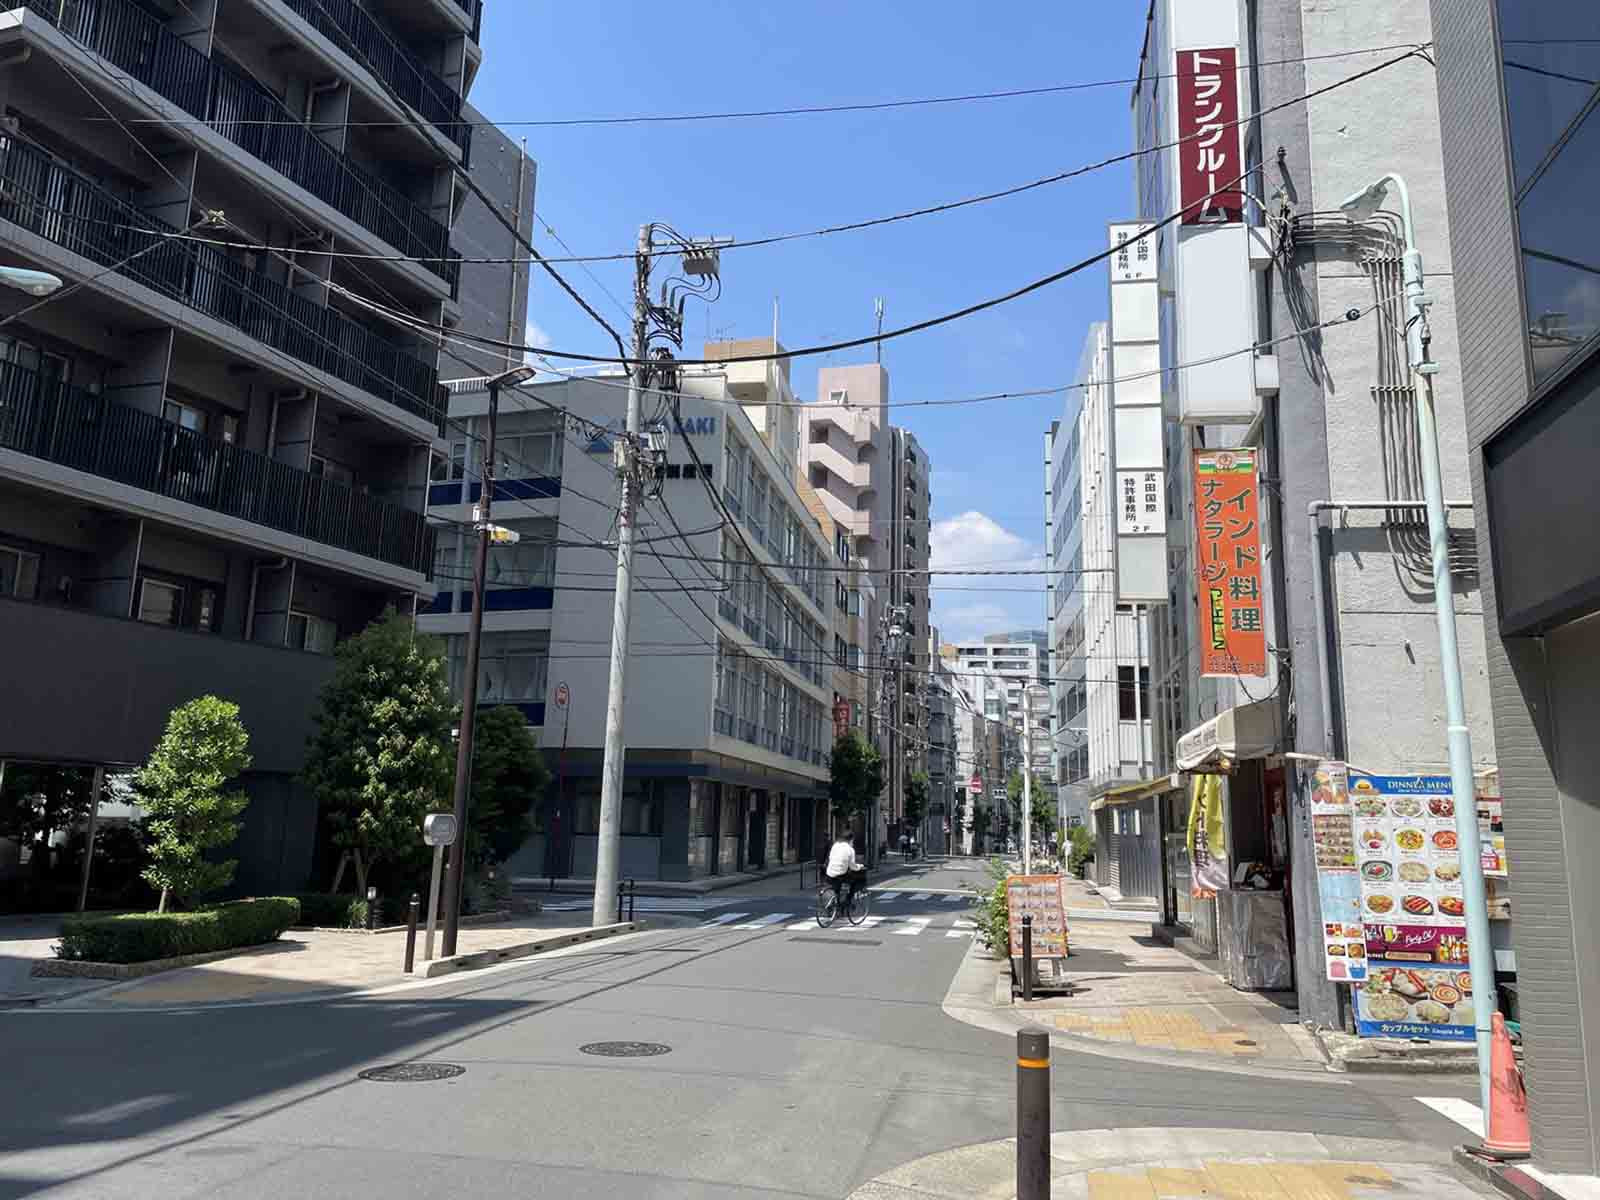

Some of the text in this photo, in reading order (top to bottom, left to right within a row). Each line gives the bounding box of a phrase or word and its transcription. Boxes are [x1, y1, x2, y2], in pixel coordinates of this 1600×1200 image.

[1192, 51, 1228, 222] トランクルーム
[1124, 478, 1137, 522] 特許事務所
[1144, 472, 1157, 513] 武田国際
[1201, 479, 1227, 582] ナタラージ
[1227, 488, 1261, 632] インド料理
